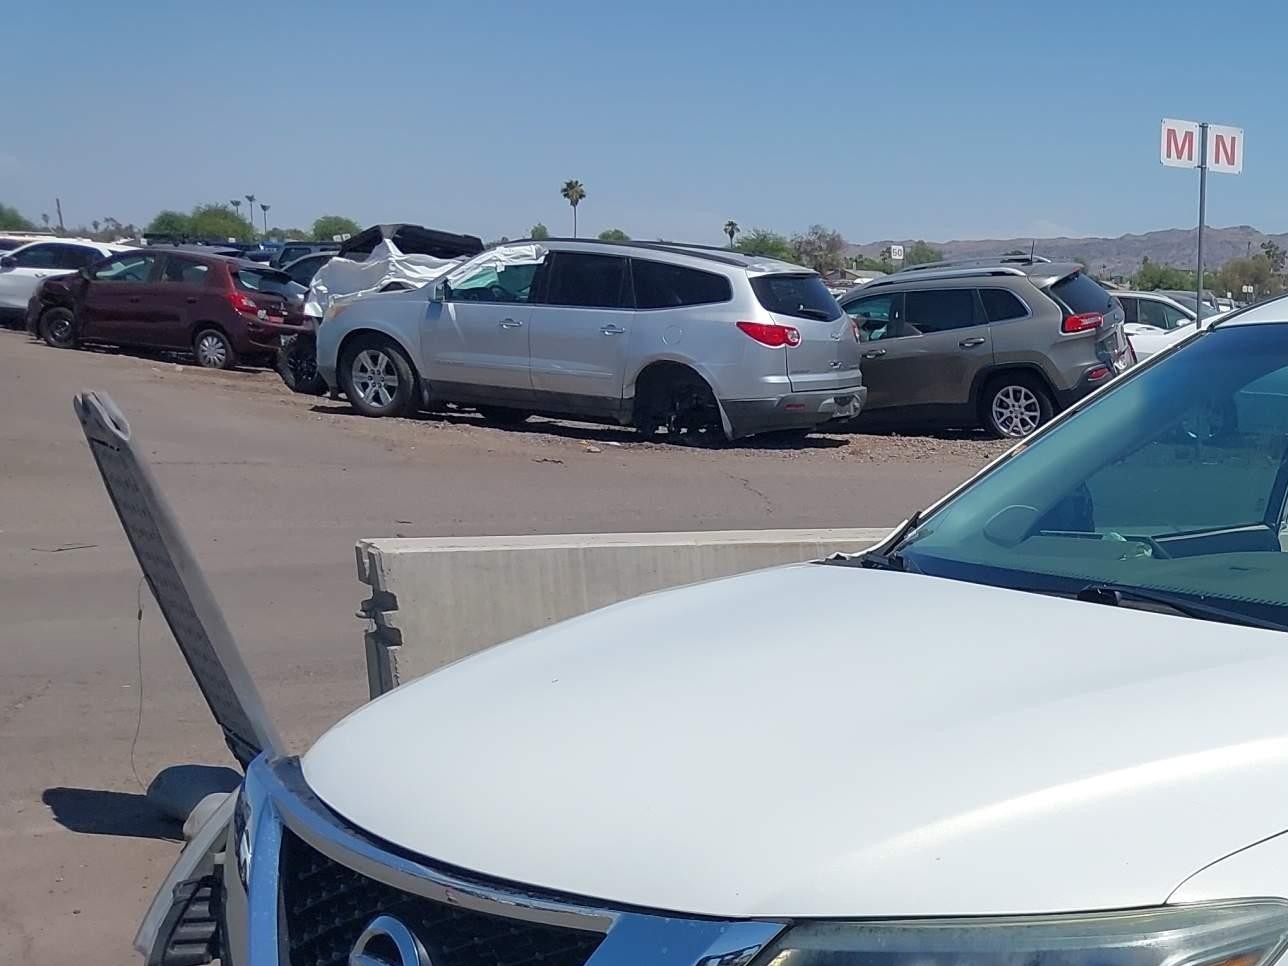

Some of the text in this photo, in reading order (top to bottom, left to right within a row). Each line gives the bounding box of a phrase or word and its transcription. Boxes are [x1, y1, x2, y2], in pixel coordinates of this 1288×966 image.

[1166, 128, 1236, 166] M N
[892, 248, 903, 257] 50
